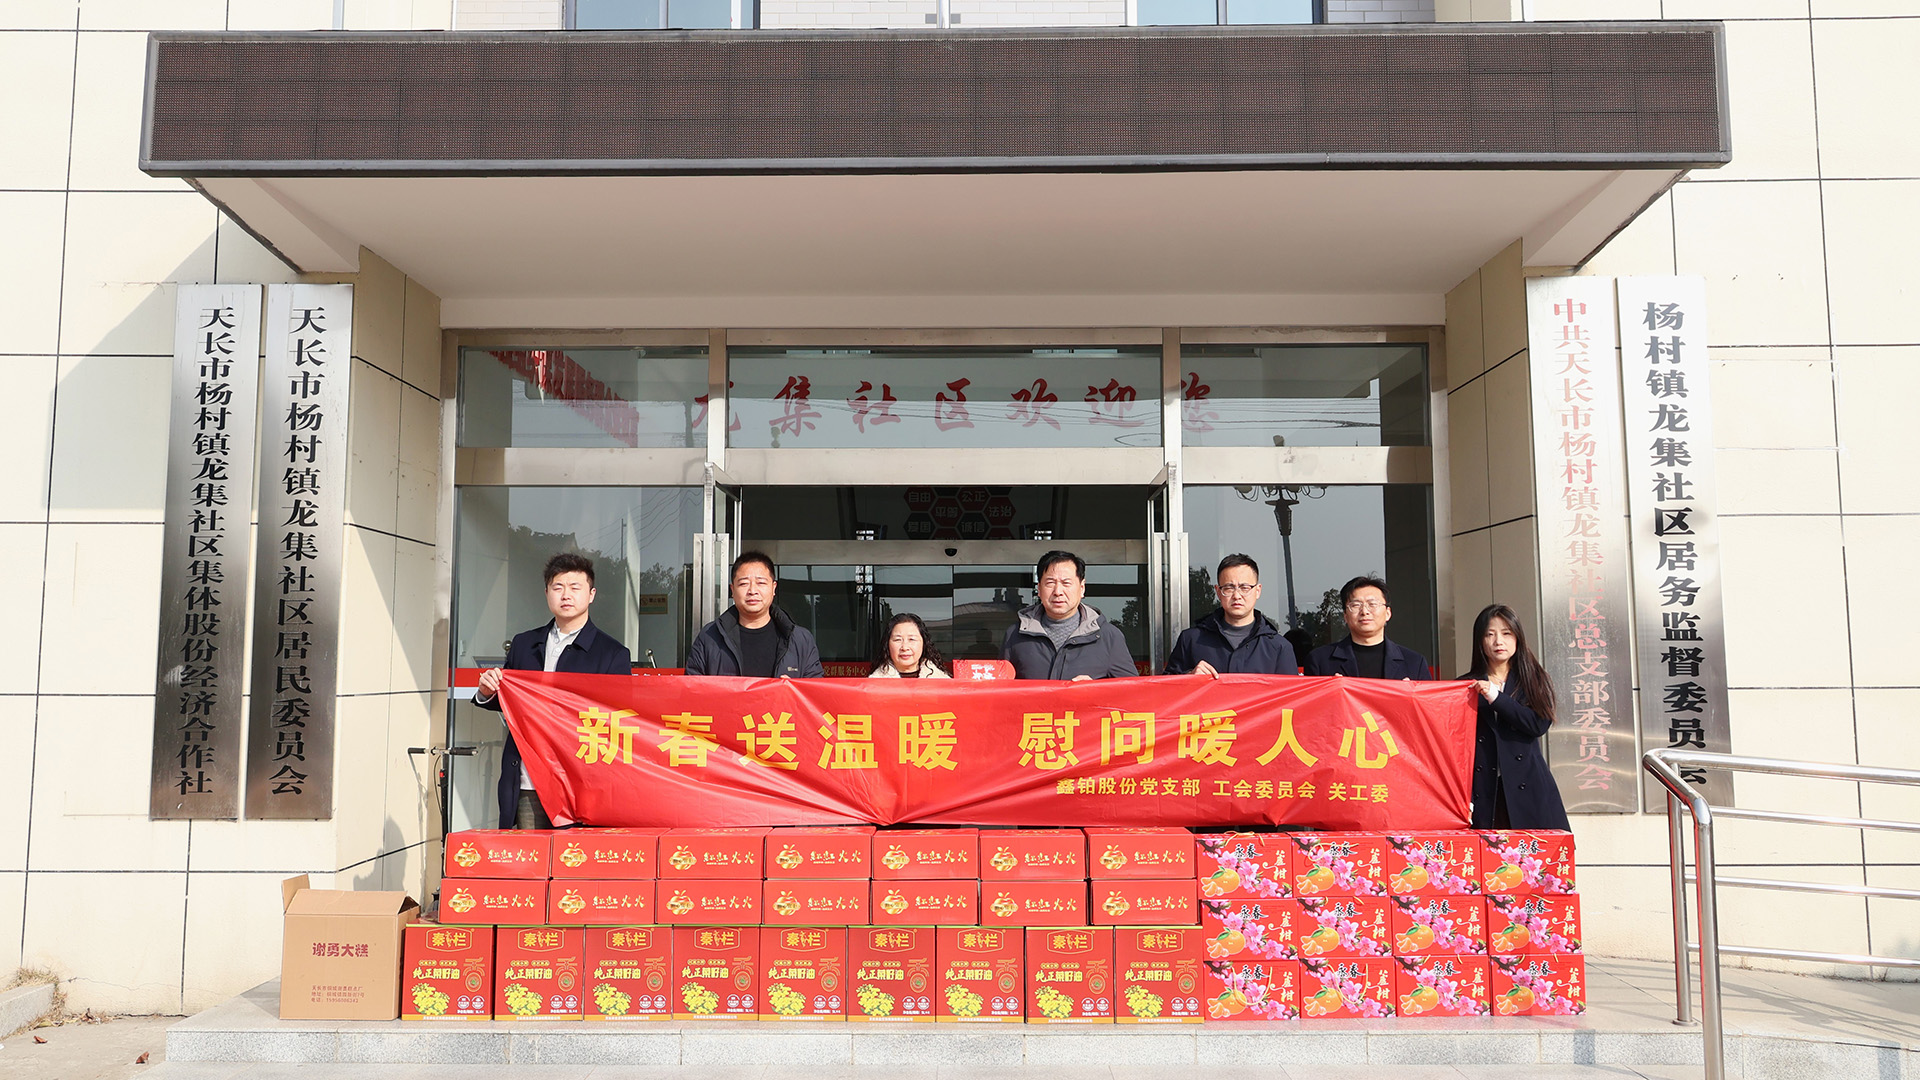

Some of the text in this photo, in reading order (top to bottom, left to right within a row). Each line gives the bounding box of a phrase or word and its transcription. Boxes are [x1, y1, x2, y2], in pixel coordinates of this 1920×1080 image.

[908, 491, 931, 503] 自由
[961, 491, 986, 503] 公正
[988, 505, 1012, 518] 法治
[961, 521, 985, 533] 诚信
[174, 305, 236, 796] 天长市杨村镇龙集社区集体股份经济合作社
[268, 305, 327, 795] 天长市杨村镇龙集社区居民委员会
[1553, 298, 1612, 791] 中共天长市杨村镇龙集社区总支部委员会
[576, 707, 1400, 771] 新春送温暖 慰问暖人心
[1056, 776, 1389, 803] 鑫铂股份党支部 工会委员会 关工委
[431, 931, 467, 947] 秦栏
[523, 931, 559, 947] 秦栏
[611, 931, 647, 947] 秦栏
[699, 930, 735, 946] 秦栏
[786, 931, 821, 947] 秦栏
[874, 932, 910, 948] 秦栏
[963, 933, 998, 948] 秦栏
[1052, 933, 1087, 949] 秦栏
[1142, 933, 1178, 949] 秦栏
[312, 942, 369, 957] 谢勇大糕
[412, 967, 461, 980] 纯正菜籽油
[504, 967, 553, 980] 纯正菜籽油
[593, 967, 642, 980] 纯正菜籽油
[681, 966, 729, 979] 纯正菜籽油
[767, 967, 816, 980] 纯正菜籽油
[856, 967, 905, 981] 纯正菜籽油
[945, 968, 993, 981] 纯正菜籽油
[1035, 970, 1083, 983] 纯正菜籽油
[1125, 969, 1173, 982] 纯正菜籽油
